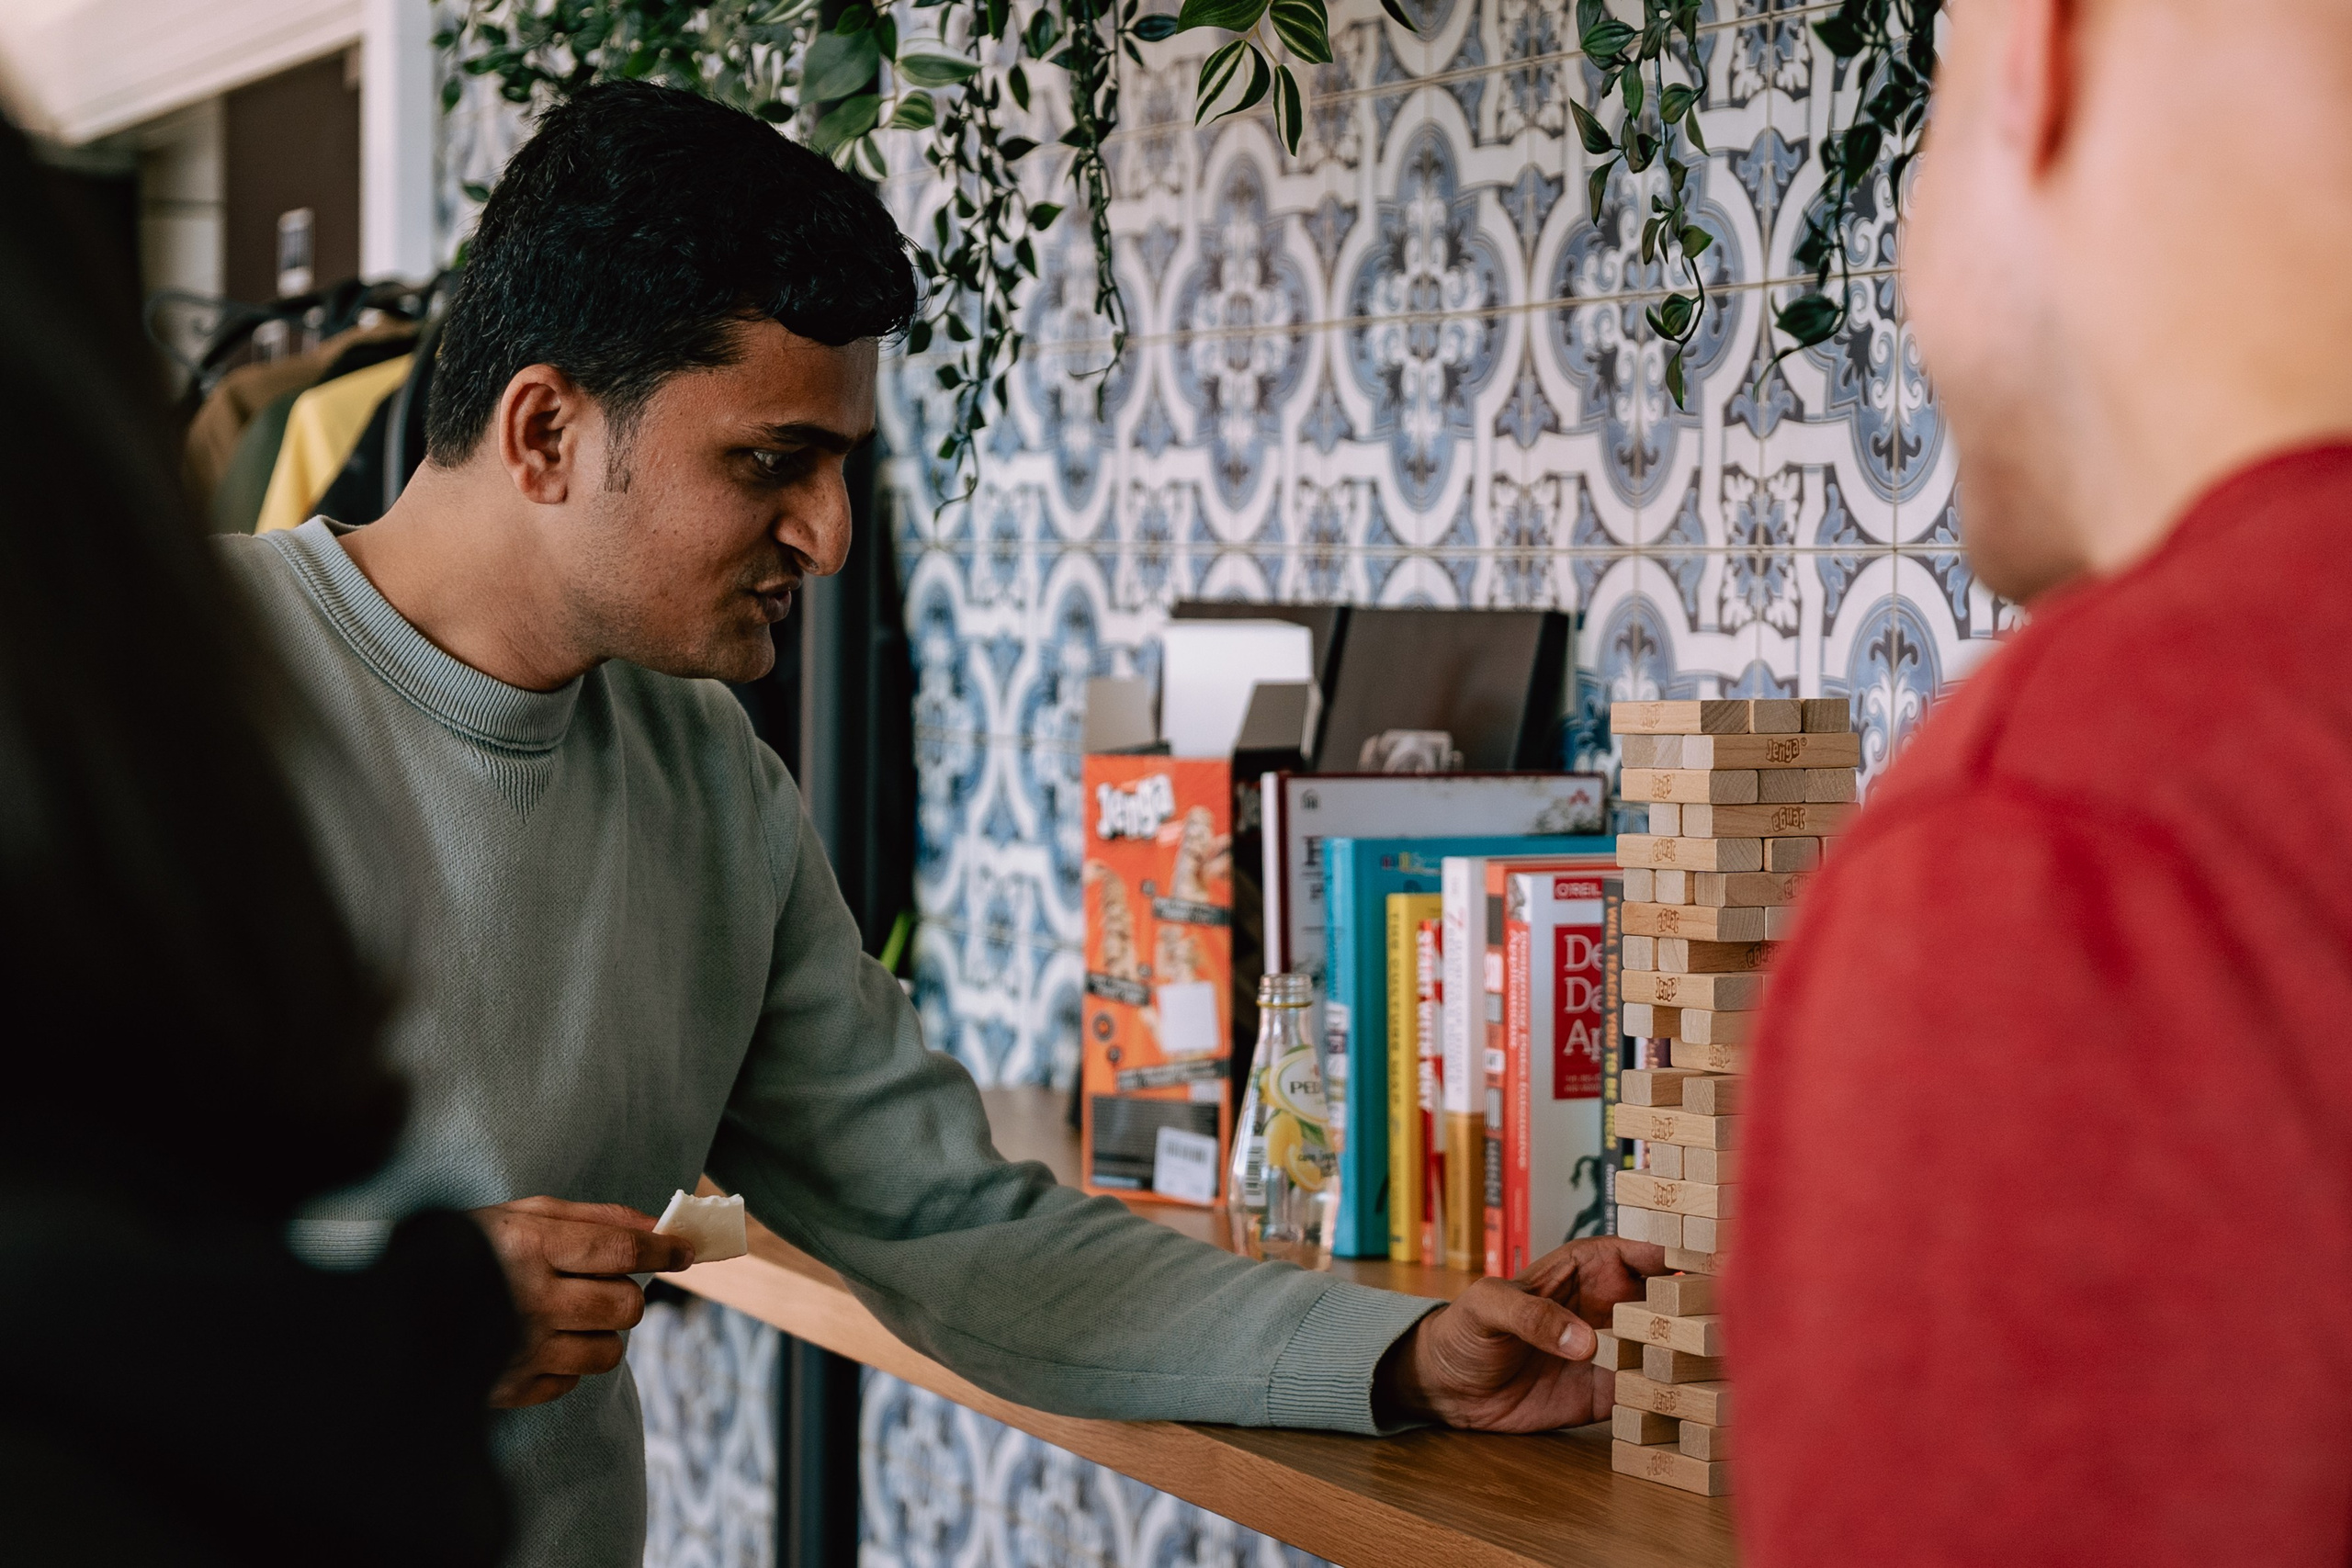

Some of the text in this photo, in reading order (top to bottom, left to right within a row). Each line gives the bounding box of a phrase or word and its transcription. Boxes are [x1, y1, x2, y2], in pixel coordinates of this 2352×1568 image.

[1095, 773, 1174, 840] Jenga
[1607, 895, 1618, 904] I
[1607, 906, 1618, 947] WILL
[1606, 953, 1618, 1010] TEACH
[1417, 931, 1432, 1110] START WITH WHY
[1606, 1010, 1617, 1048] YOU
[1605, 1051, 1617, 1074] TO
[1604, 1077, 1617, 1100] BE
